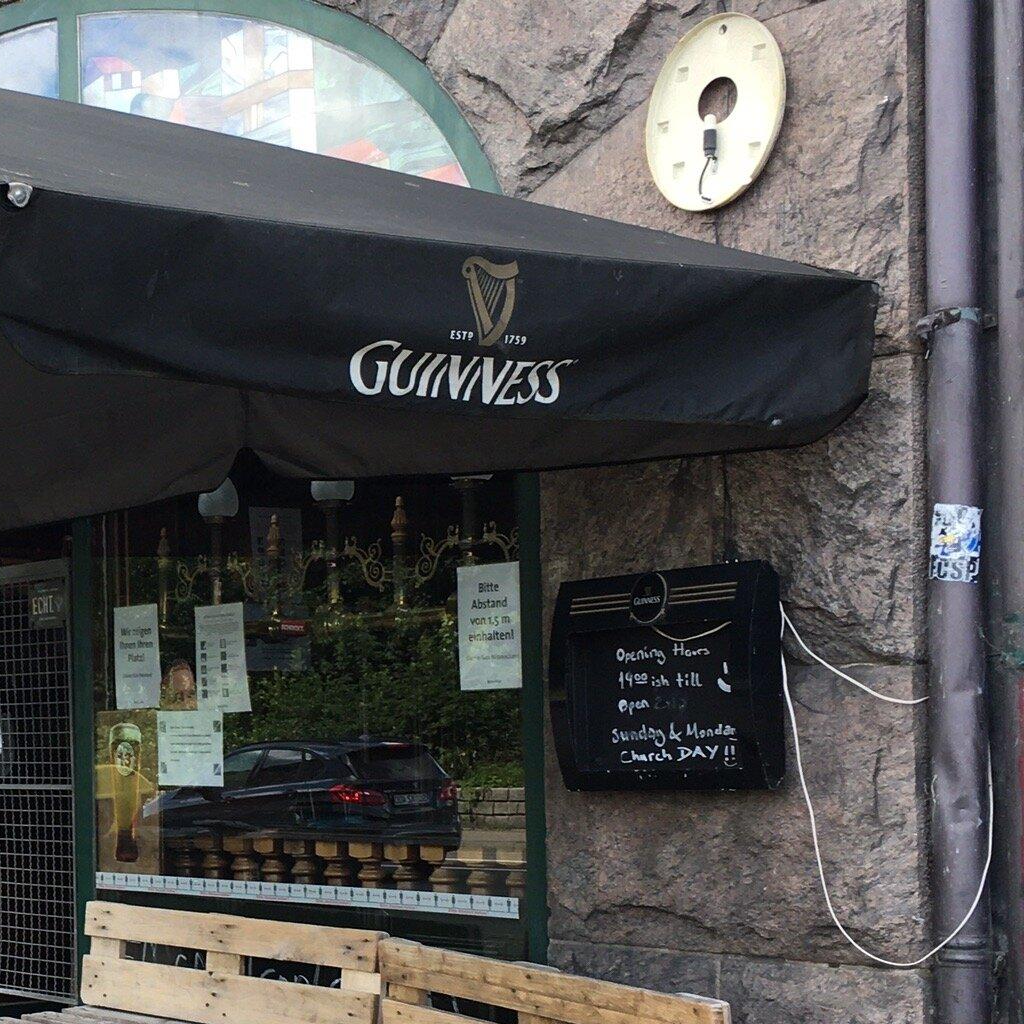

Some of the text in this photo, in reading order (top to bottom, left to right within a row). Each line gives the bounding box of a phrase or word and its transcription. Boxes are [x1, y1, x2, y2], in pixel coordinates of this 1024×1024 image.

[504, 334, 527, 345] 1759
[349, 340, 574, 405] GUINNESS
[478, 582, 499, 593] Bitte
[471, 597, 507, 610] Abstand
[470, 617, 486, 626] von
[468, 629, 515, 642] einhalten!
[616, 647, 666, 665] Opening
[651, 675, 670, 687] ish
[676, 672, 703, 688] till
[611, 723, 666, 748] Sunday
[669, 722, 683, 742] &
[620, 748, 673, 764] Church
[676, 745, 719, 762] DAY
